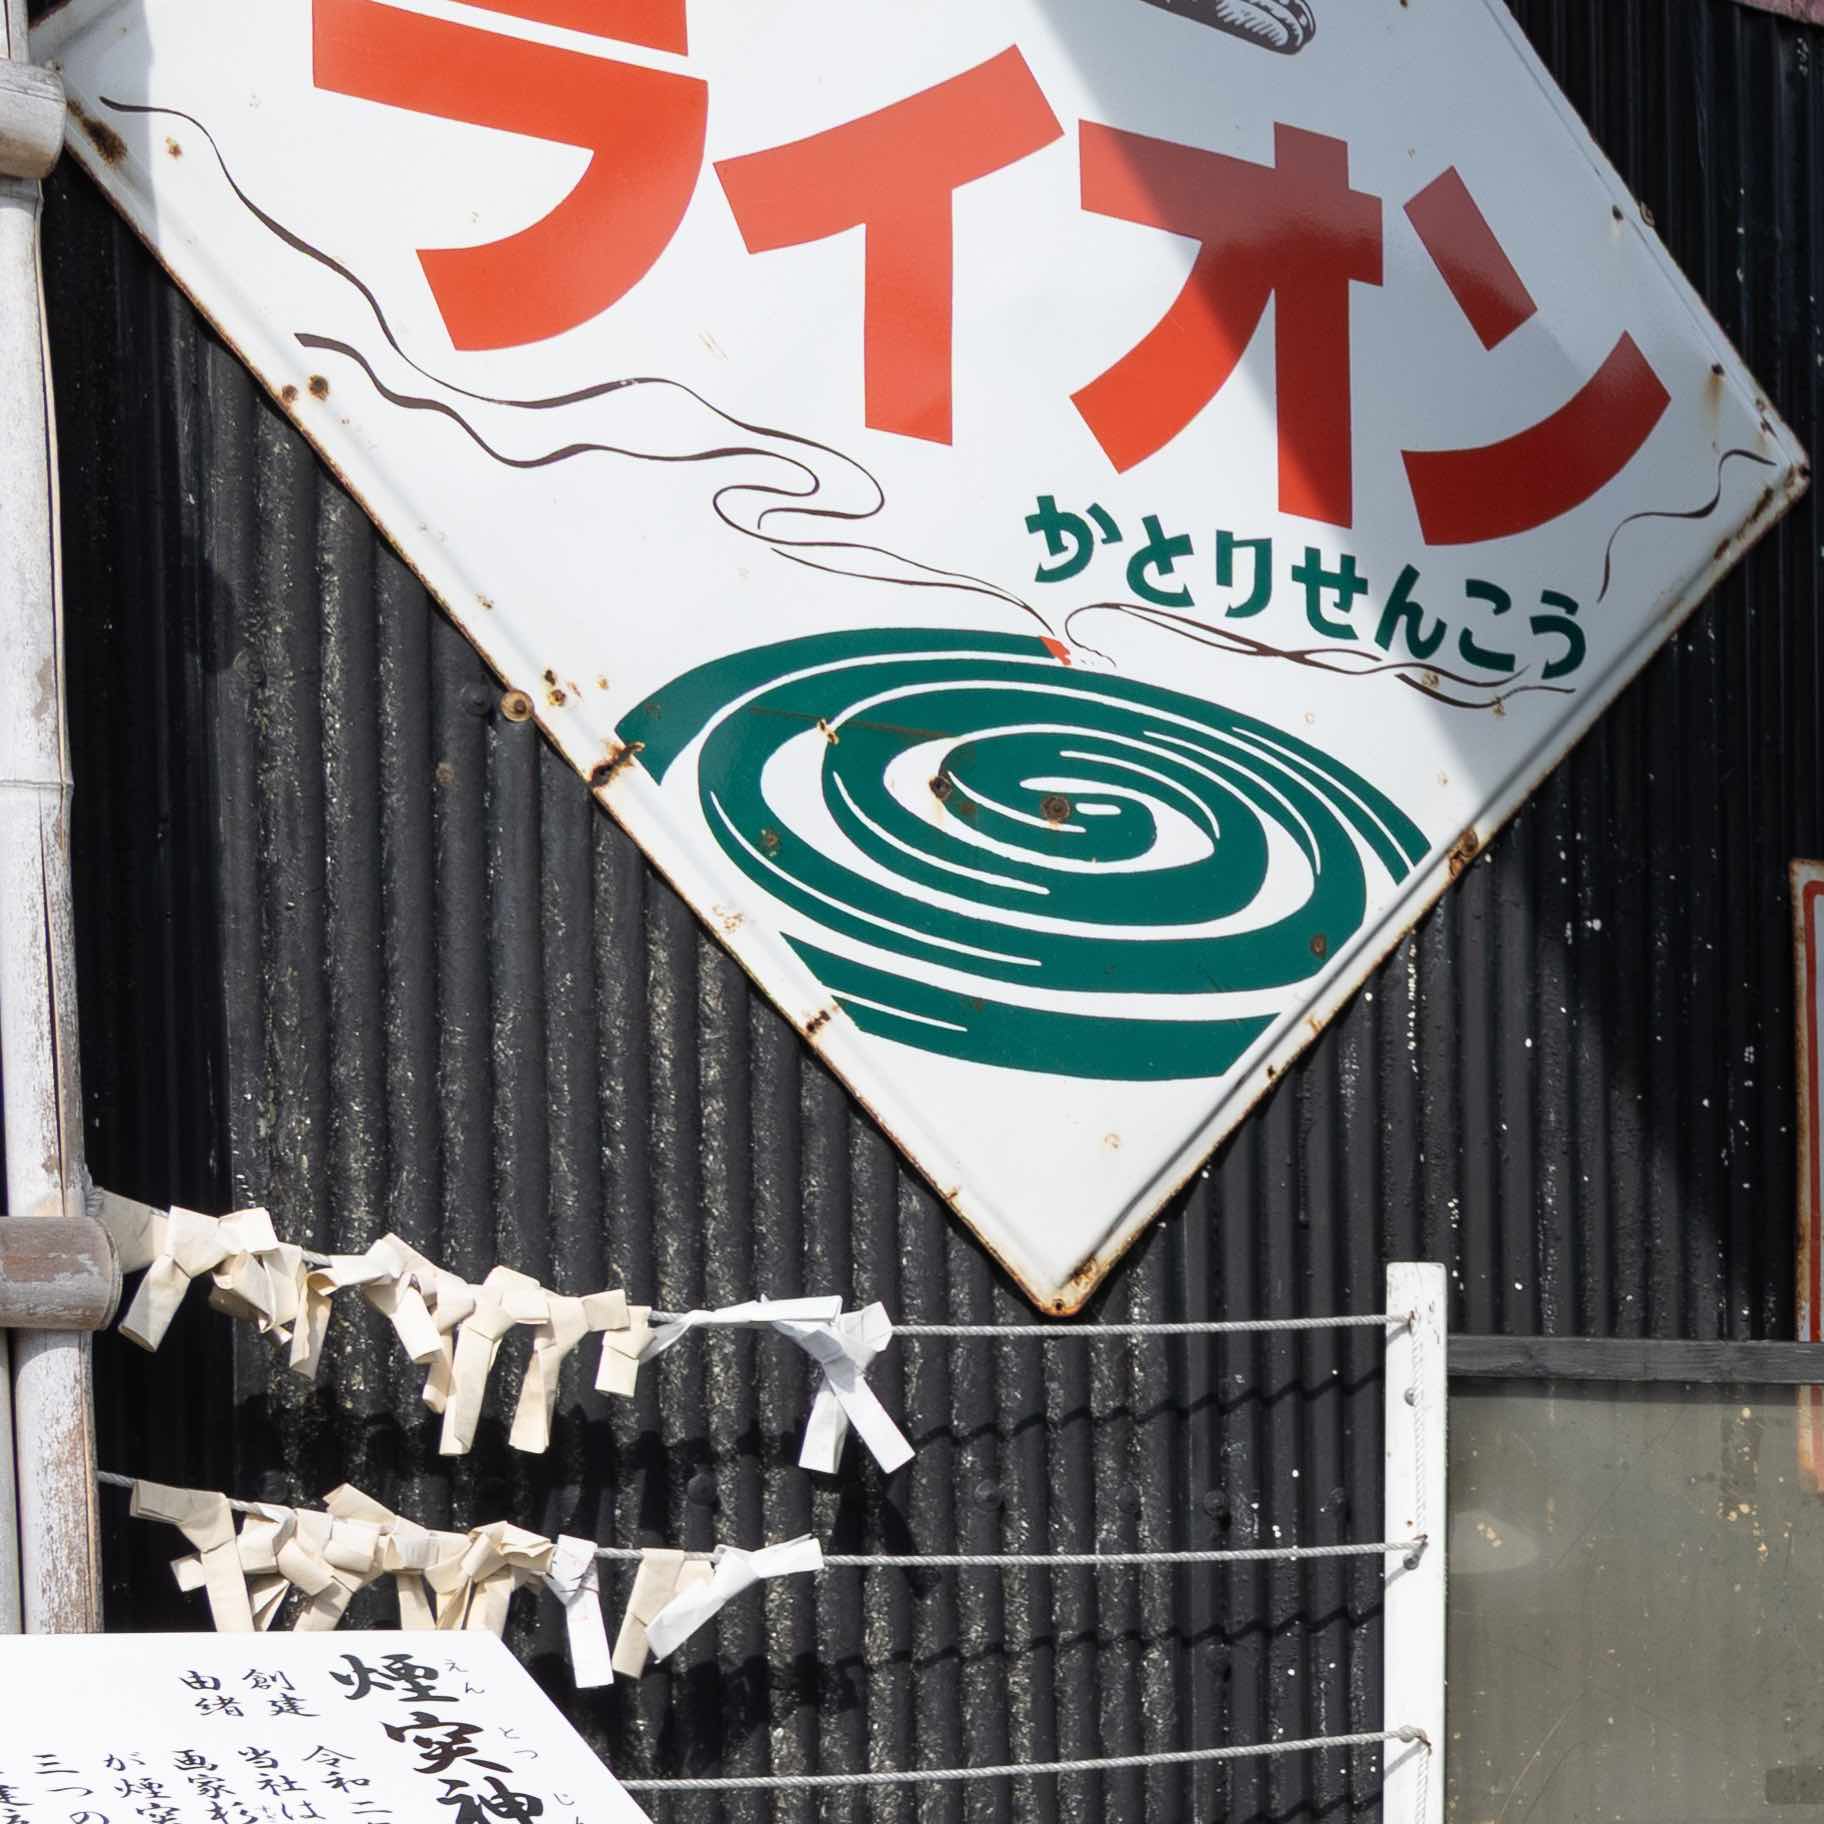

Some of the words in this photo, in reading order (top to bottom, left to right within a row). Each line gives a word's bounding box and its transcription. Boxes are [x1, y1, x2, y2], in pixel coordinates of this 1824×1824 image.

[311, 0, 1672, 547] ライオン
[1024, 494, 1588, 680] かとりせんこう
[178, 1670, 245, 1717] 由緒
[241, 1667, 321, 1717] 創建
